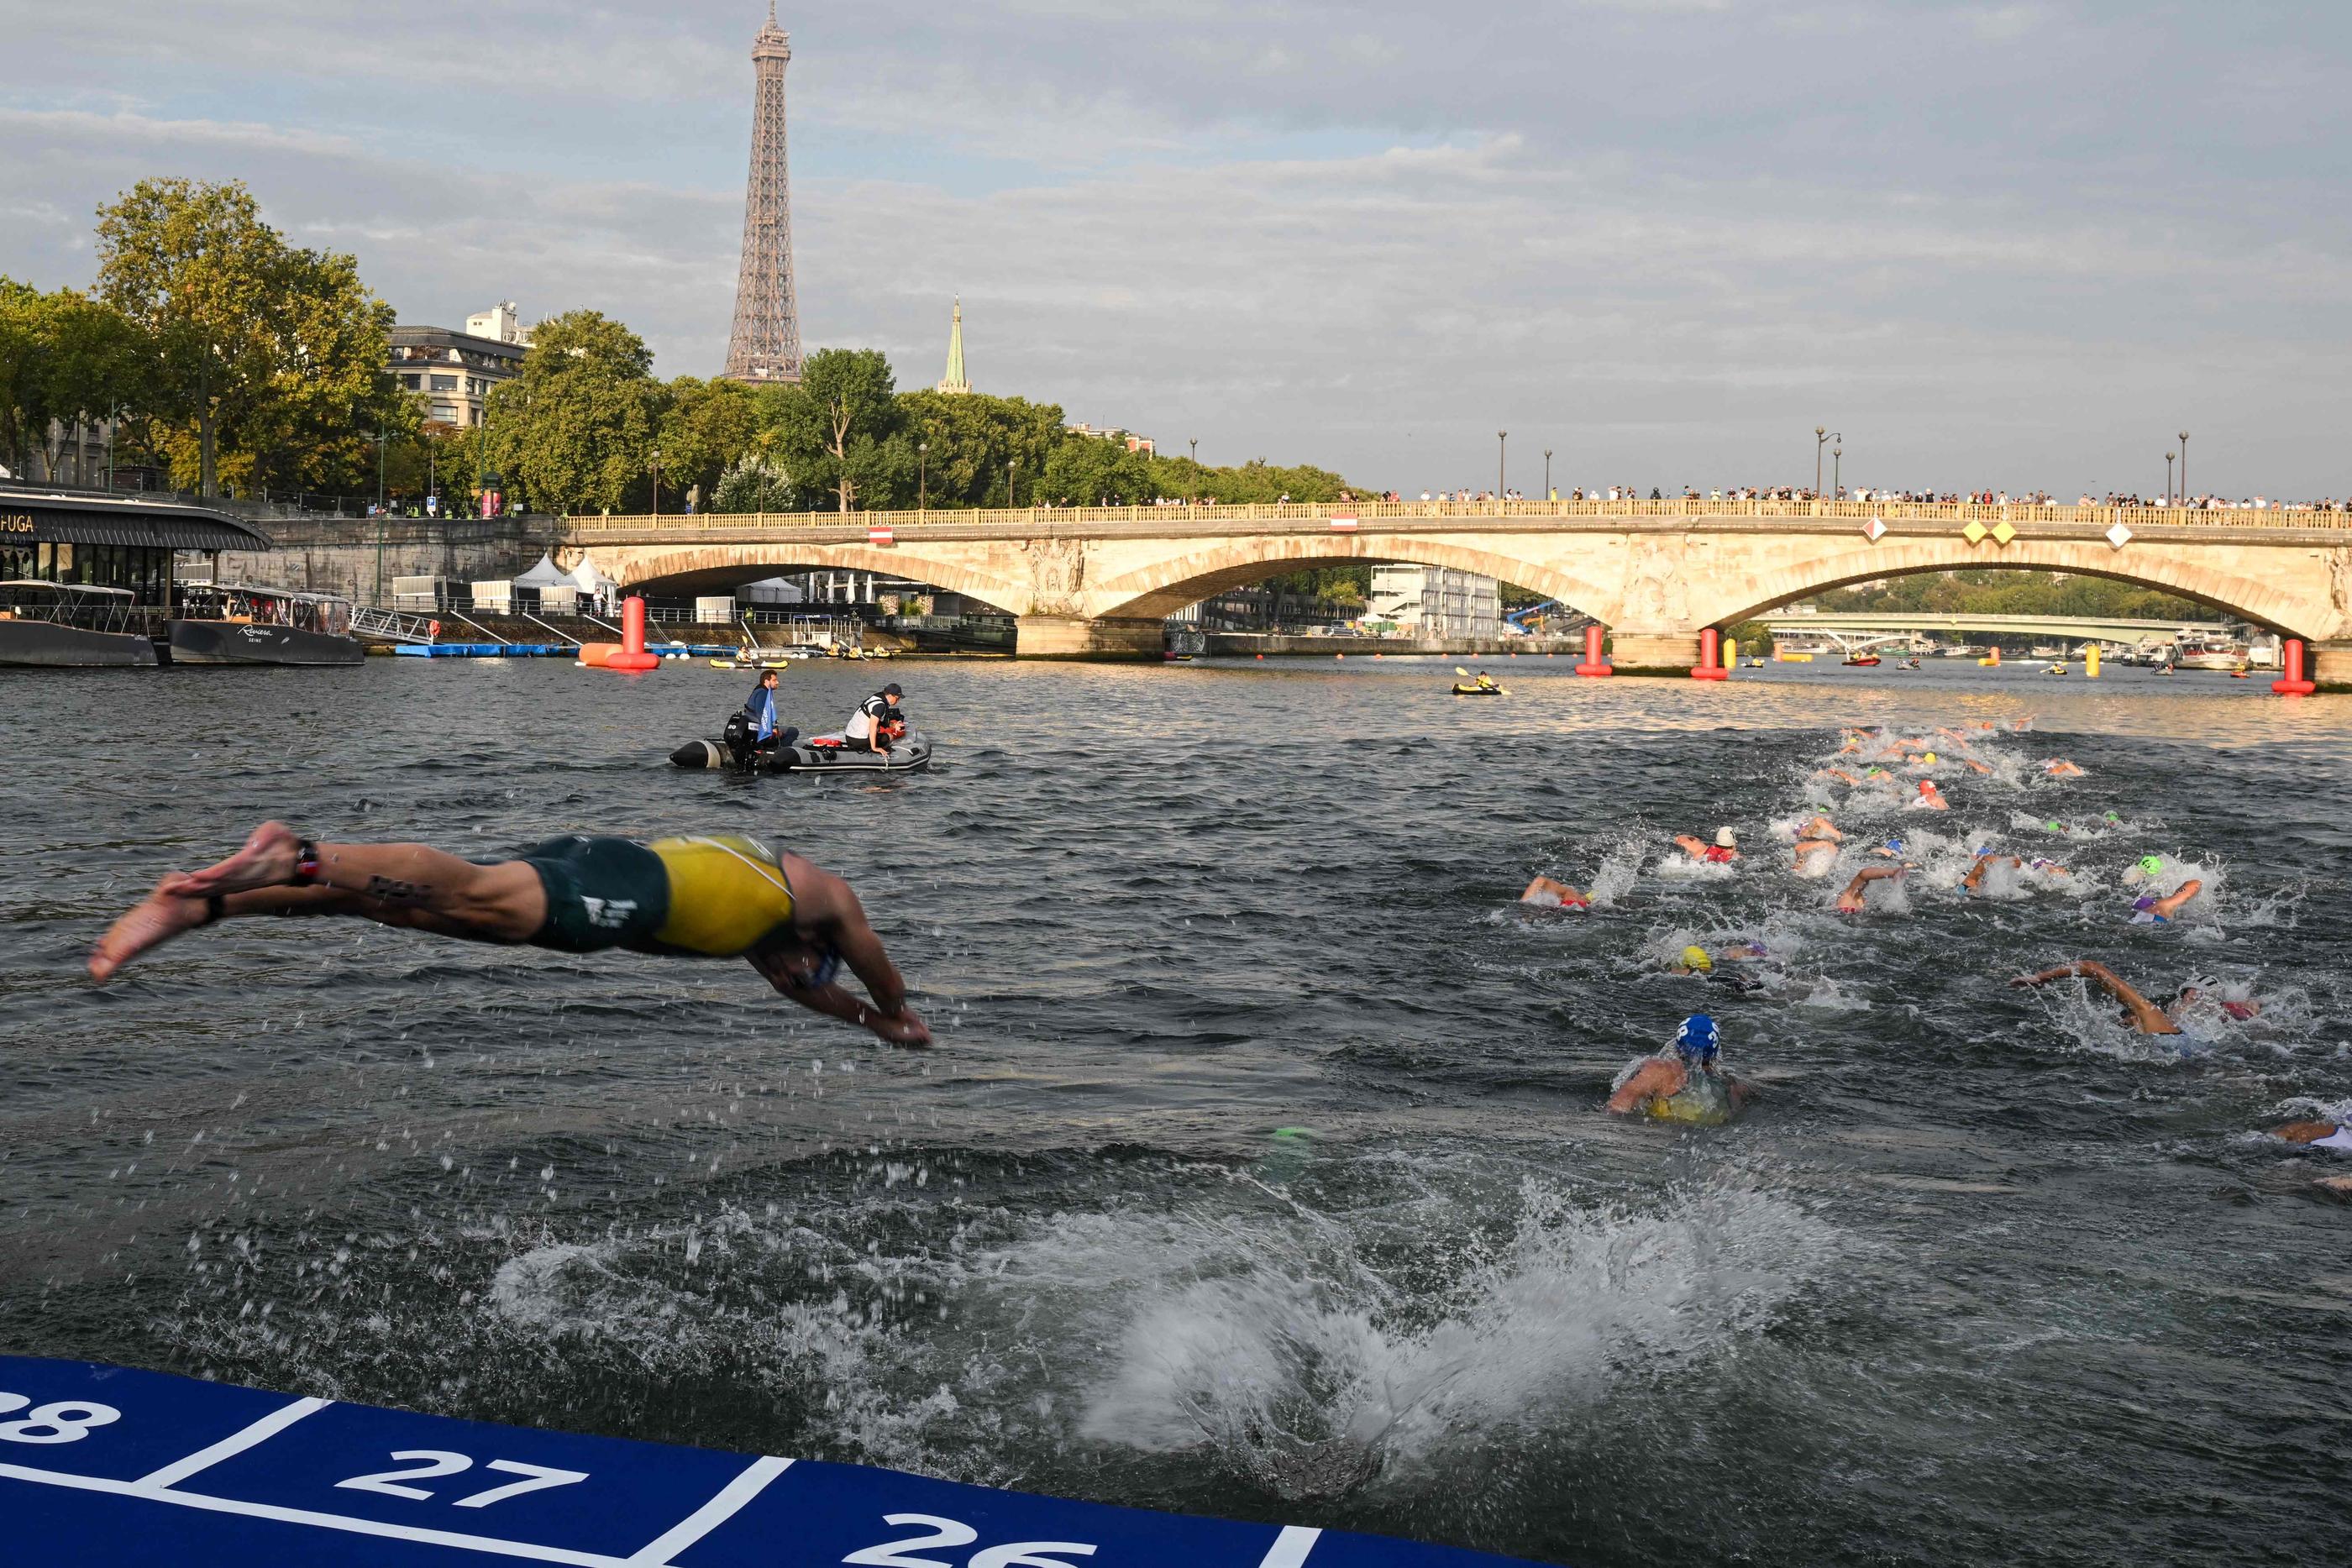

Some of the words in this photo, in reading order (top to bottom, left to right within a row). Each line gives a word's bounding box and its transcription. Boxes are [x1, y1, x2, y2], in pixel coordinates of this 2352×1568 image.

[237, 624, 273, 637] Riviera
[0, 1392, 121, 1444] 8
[333, 1450, 591, 1508] 27
